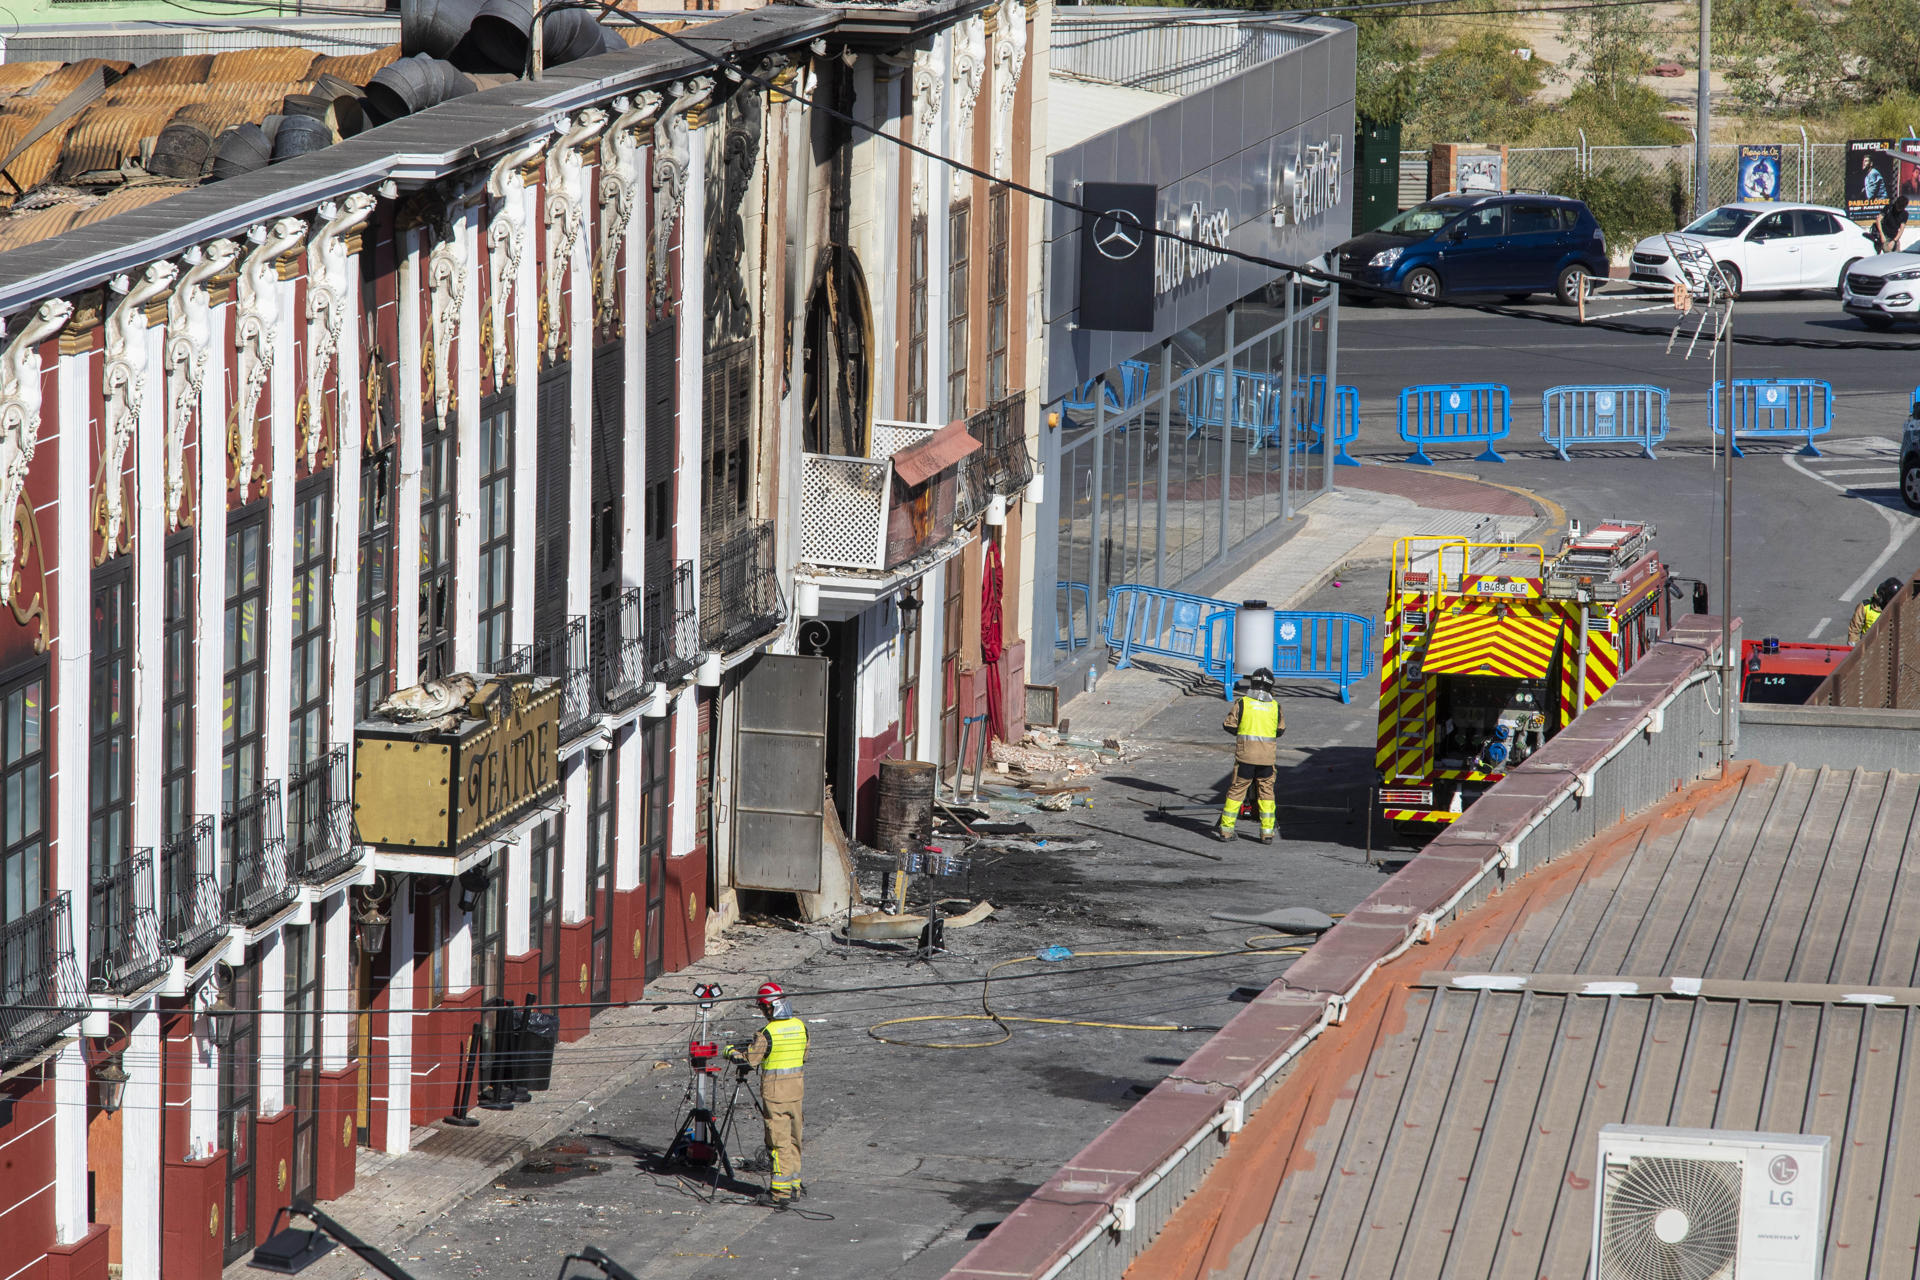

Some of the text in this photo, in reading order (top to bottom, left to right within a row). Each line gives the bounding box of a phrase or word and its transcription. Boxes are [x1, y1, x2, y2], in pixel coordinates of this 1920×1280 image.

[1848, 199, 1869, 207] PABLO
[1154, 201, 1230, 297] Auto Classe
[1484, 582, 1526, 593] 8483 GLF
[1764, 677, 1786, 685] L14
[468, 721, 548, 825] TEATRE
[1769, 1190, 1793, 1206] LG
